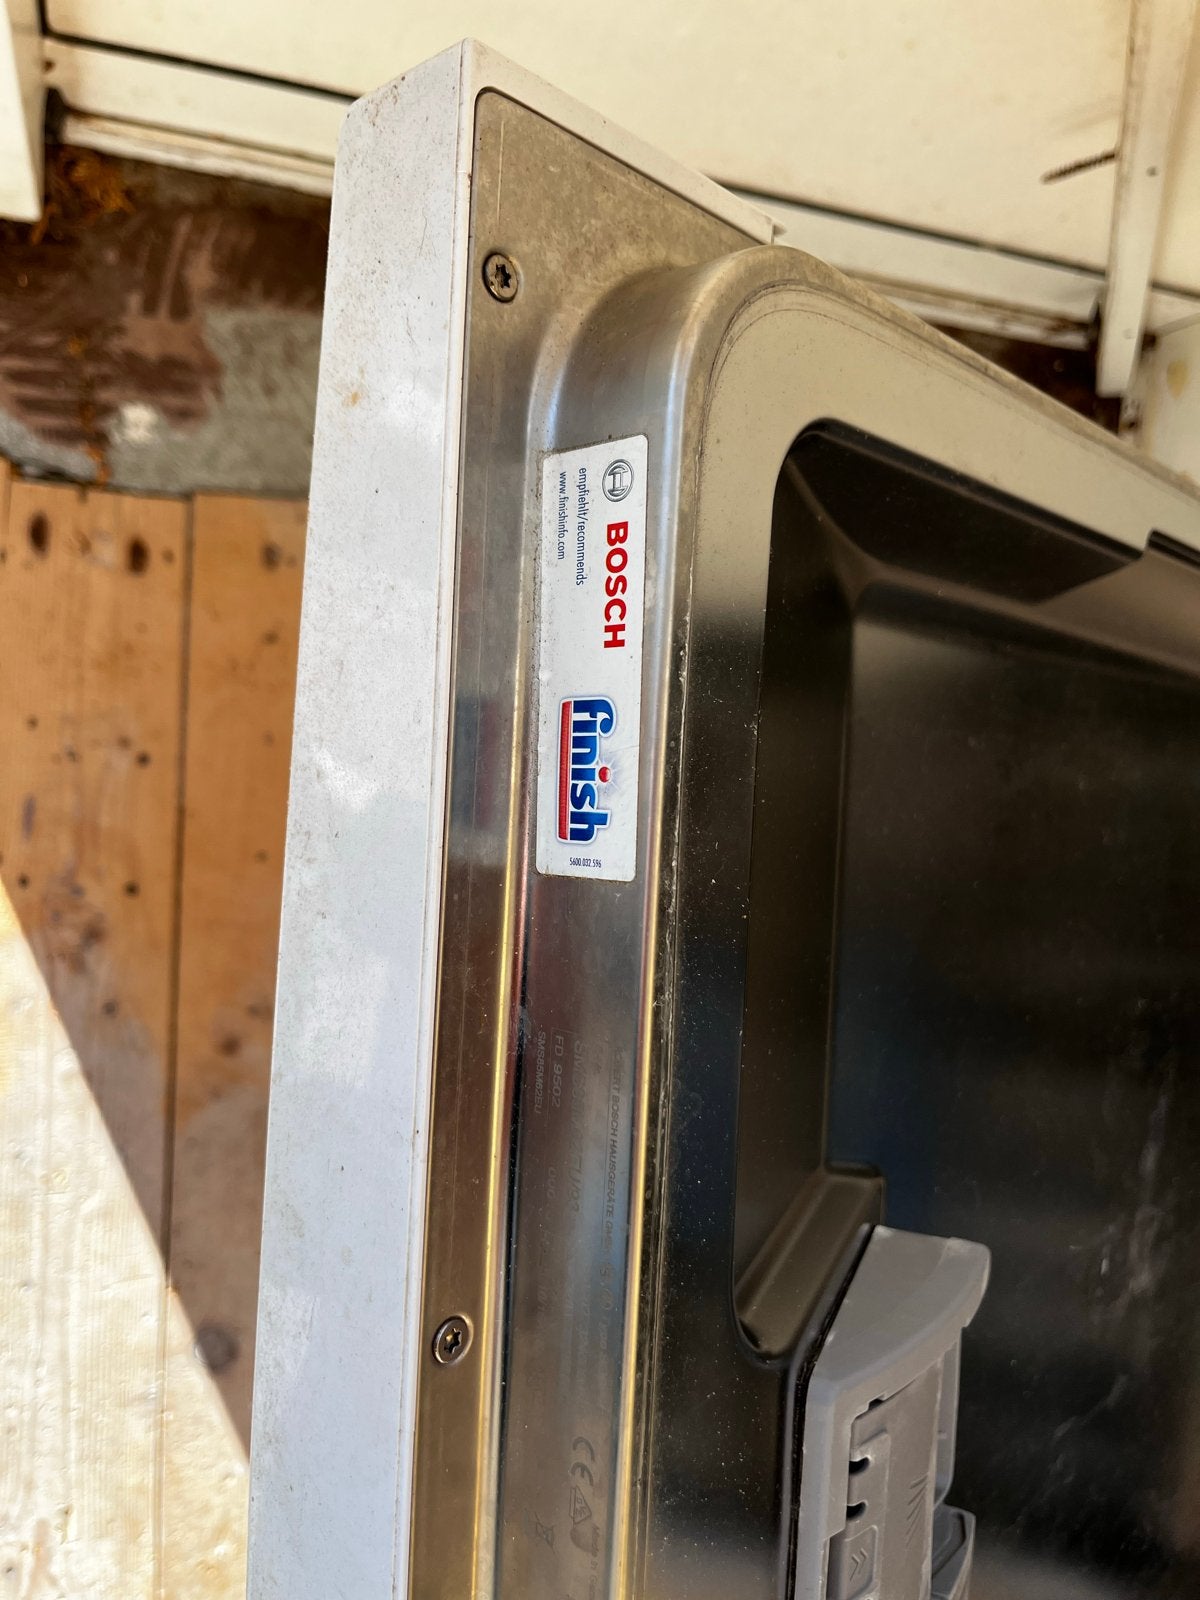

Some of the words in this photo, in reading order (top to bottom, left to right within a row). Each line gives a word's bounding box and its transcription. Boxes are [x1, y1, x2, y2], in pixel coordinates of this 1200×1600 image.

[556, 470, 570, 561] www.finishinfo.com
[574, 466, 590, 586] empfiehlt/recommends
[603, 520, 629, 649] BOSCH
[569, 697, 616, 842] finish
[569, 857, 603, 867] 5600.032.596
[554, 1034, 565, 1057] FD
[551, 1062, 564, 1109] 9502
[610, 1094, 621, 1138] BOSCH
